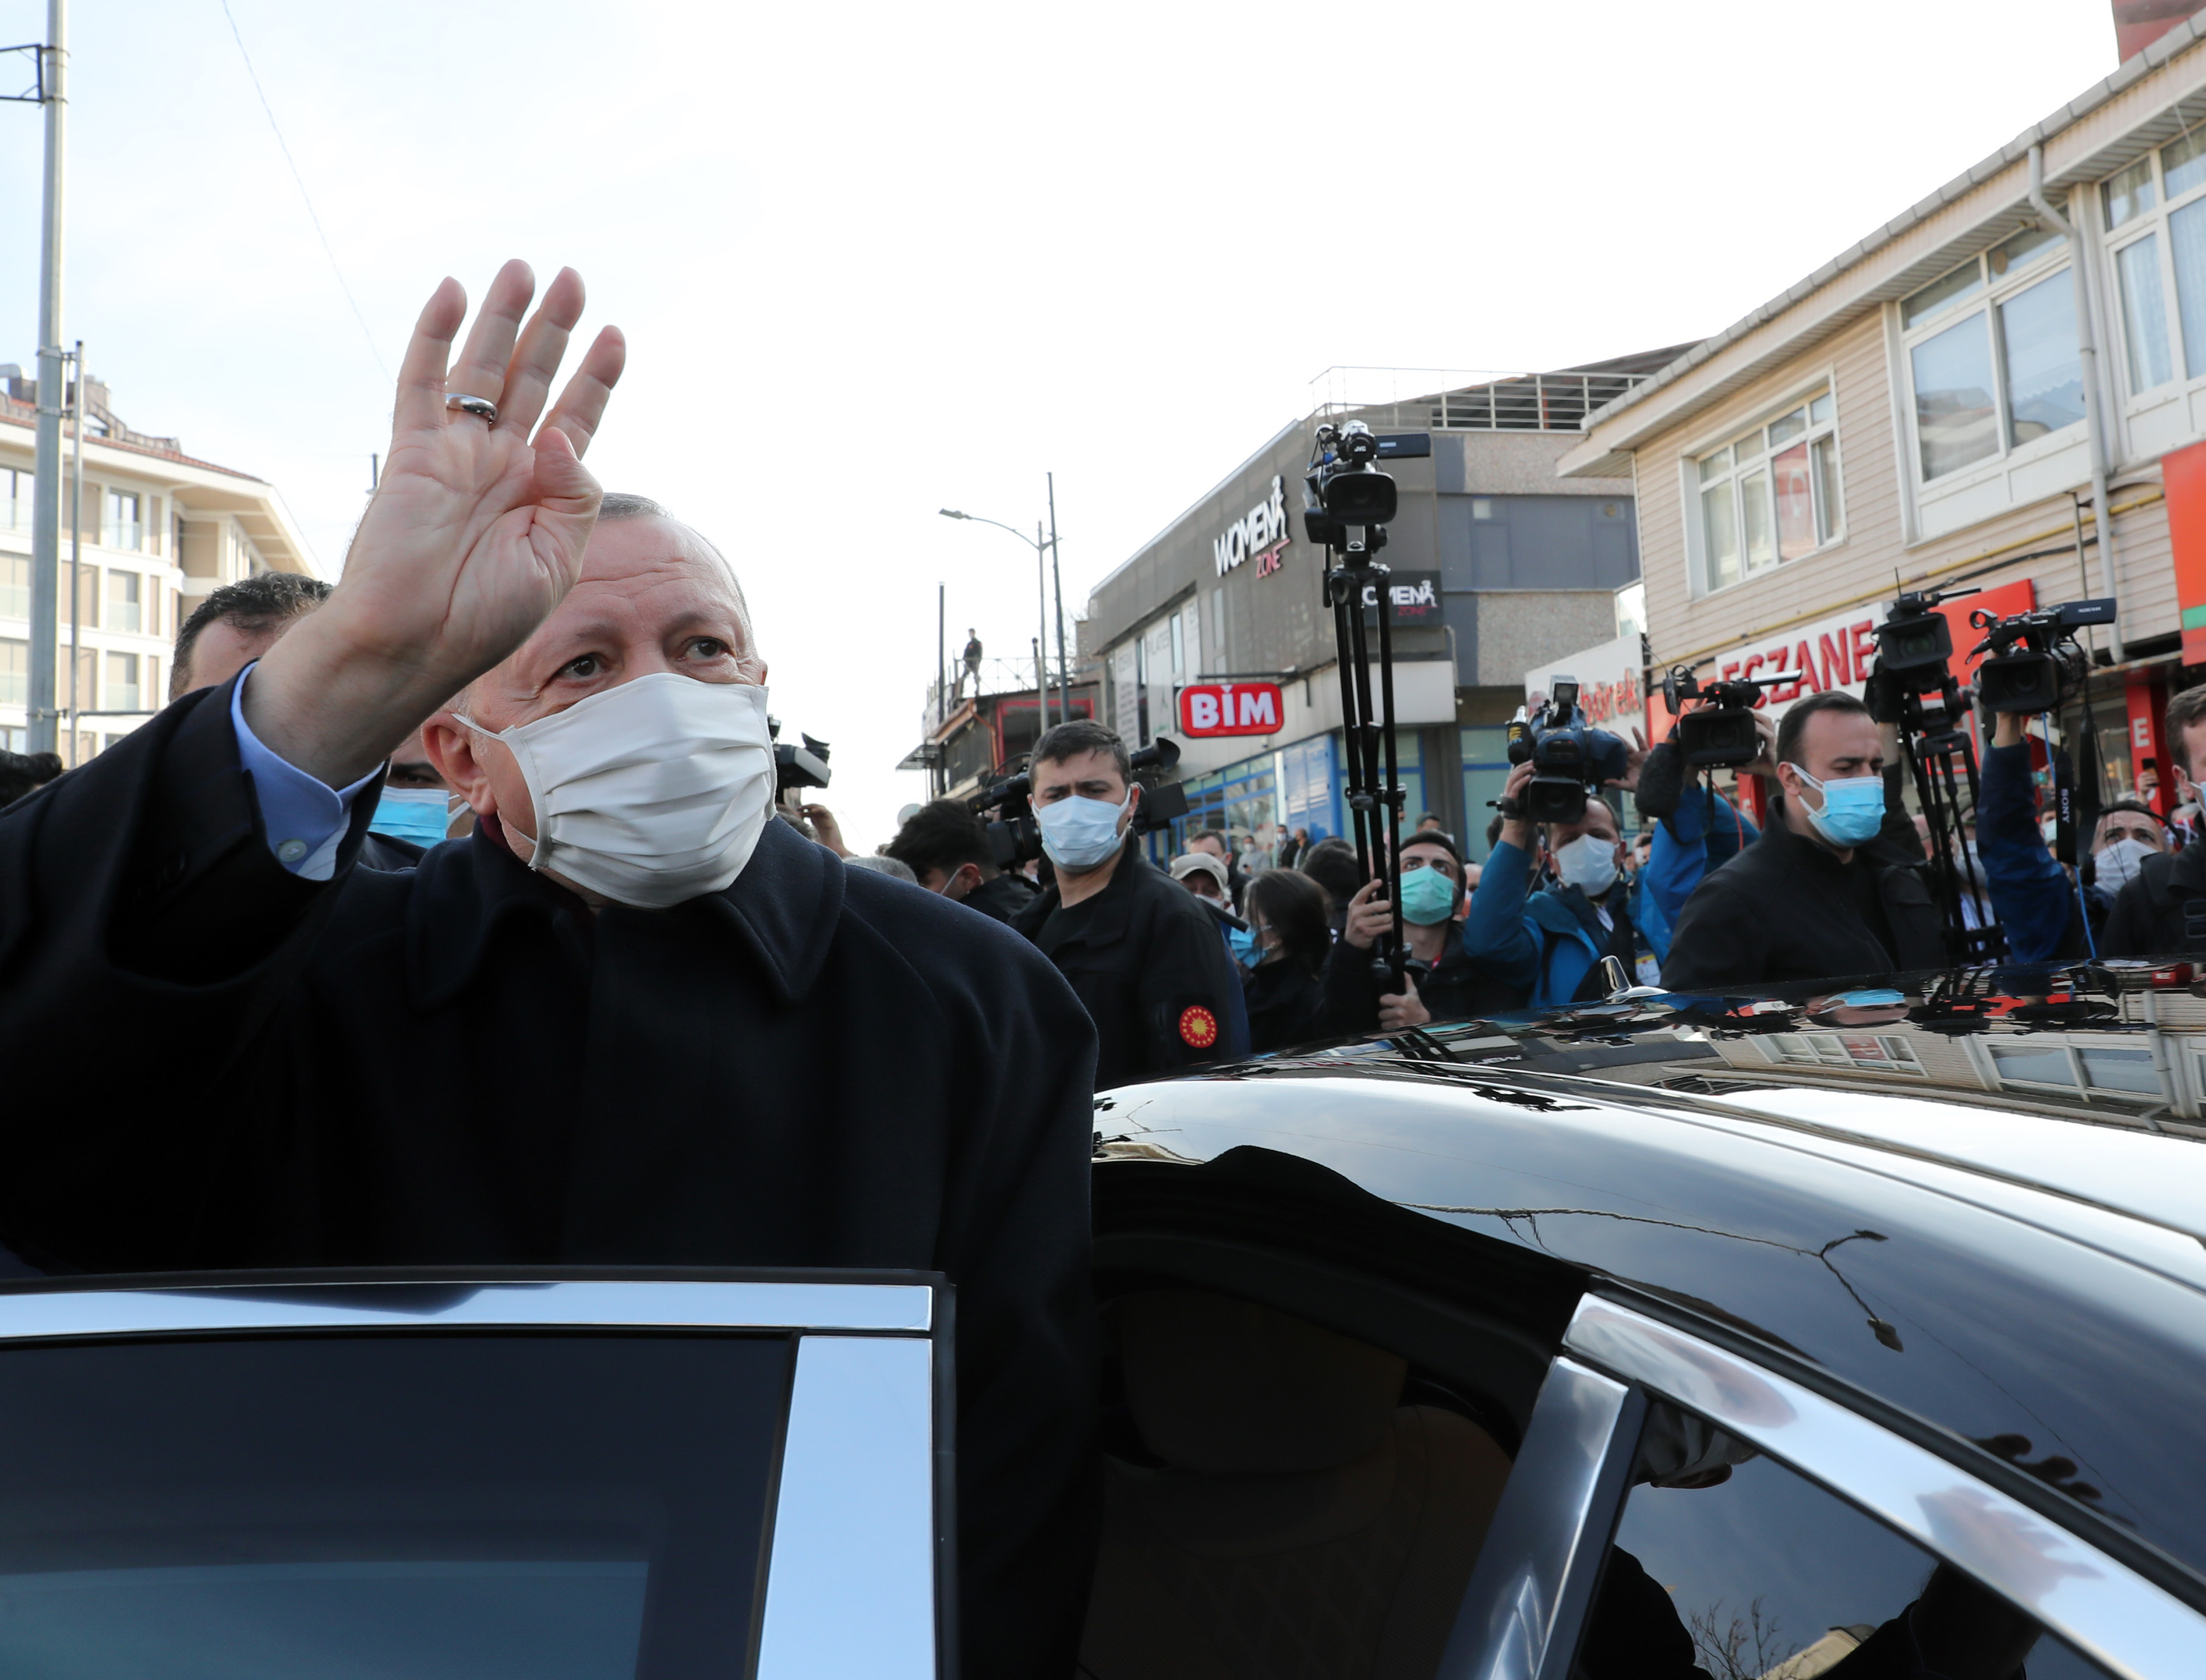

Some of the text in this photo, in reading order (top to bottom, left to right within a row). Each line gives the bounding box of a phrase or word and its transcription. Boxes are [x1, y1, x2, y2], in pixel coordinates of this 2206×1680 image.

[1256, 539, 1291, 579] ZONE
[1362, 583, 1429, 606] OMEN
[1190, 684, 1277, 729] BİM
[2060, 788, 2070, 824] SONY
